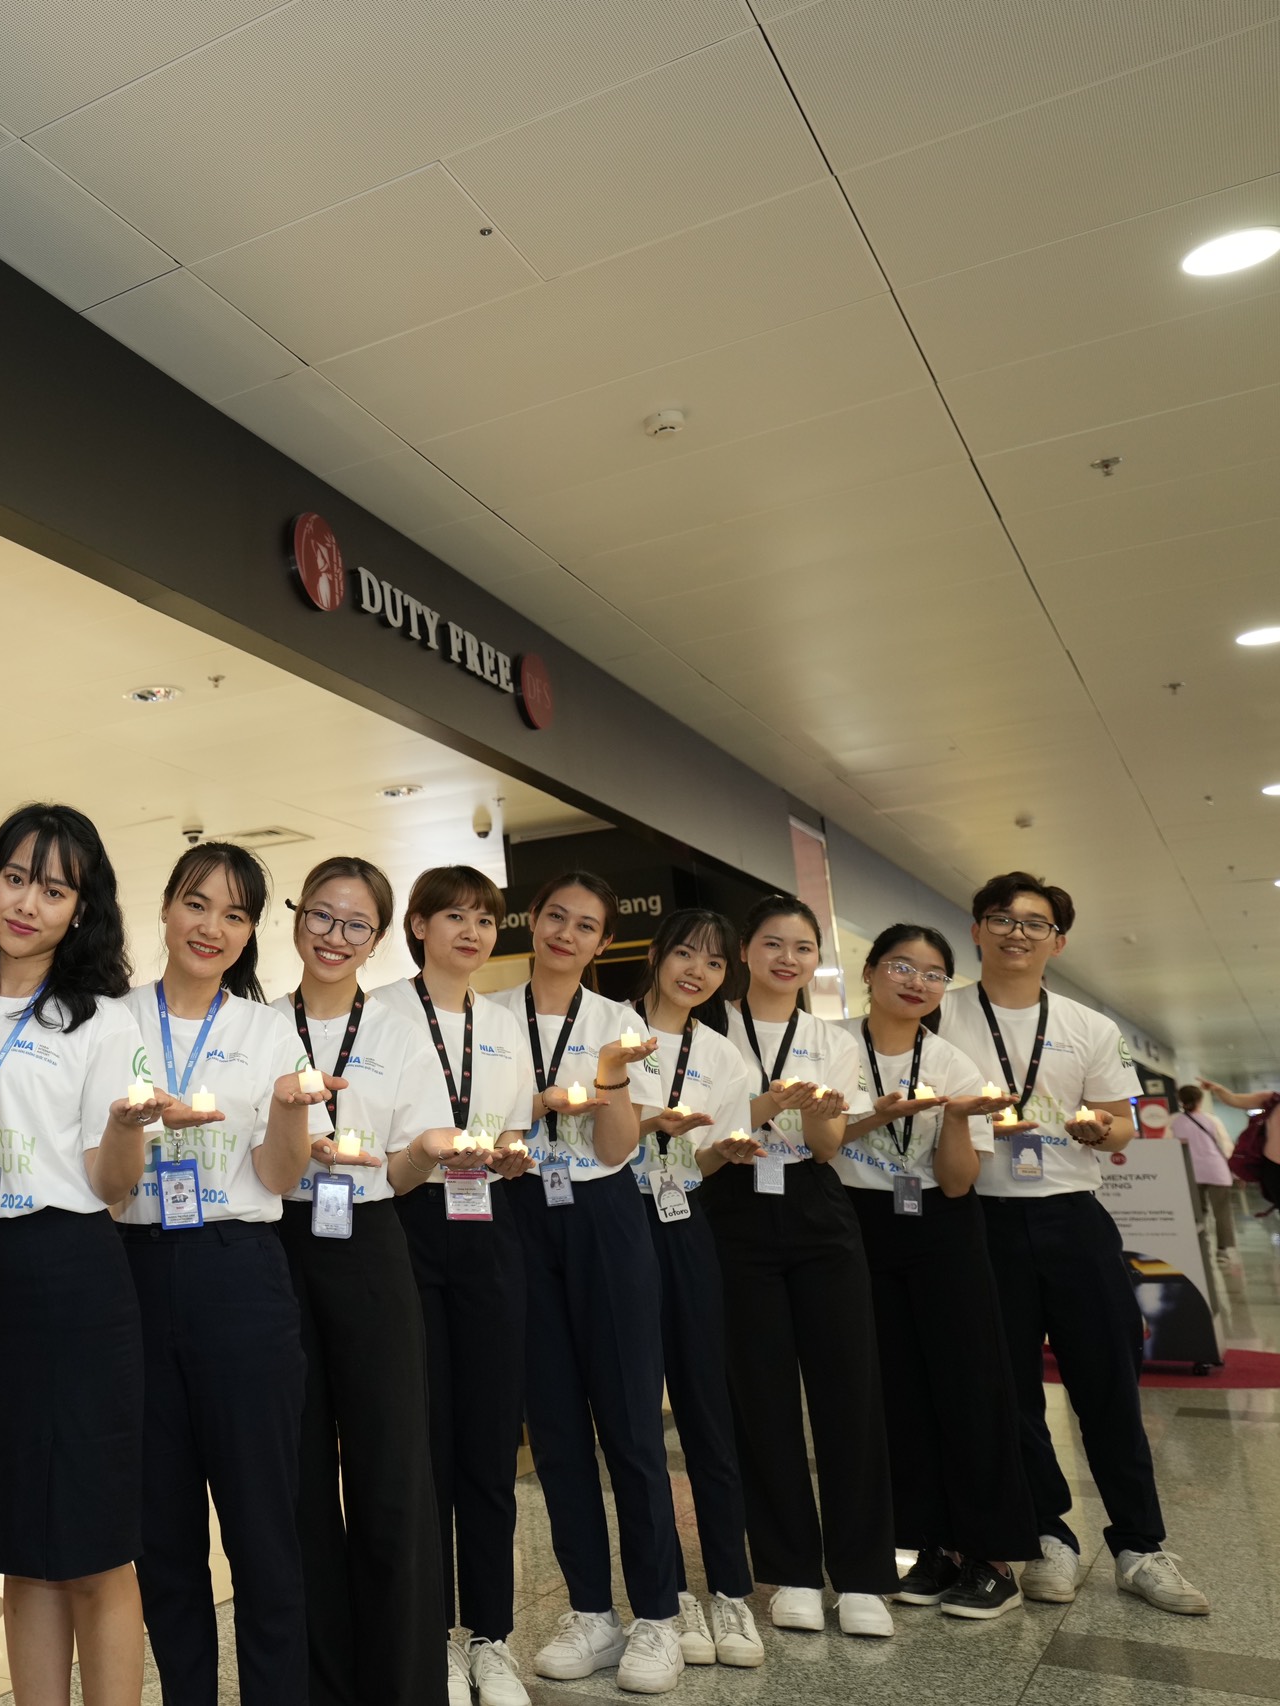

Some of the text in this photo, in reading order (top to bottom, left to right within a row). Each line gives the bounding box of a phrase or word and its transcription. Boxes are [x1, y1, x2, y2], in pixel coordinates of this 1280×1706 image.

[357, 566, 515, 694] DUTY FREE
[526, 671, 551, 710] DFS
[14, 1040, 34, 1050] NIA
[479, 1044, 495, 1053] NIA
[206, 1049, 225, 1059] NIA
[0, 1193, 34, 1209] 2024
[660, 1206, 689, 1219] Totoro
